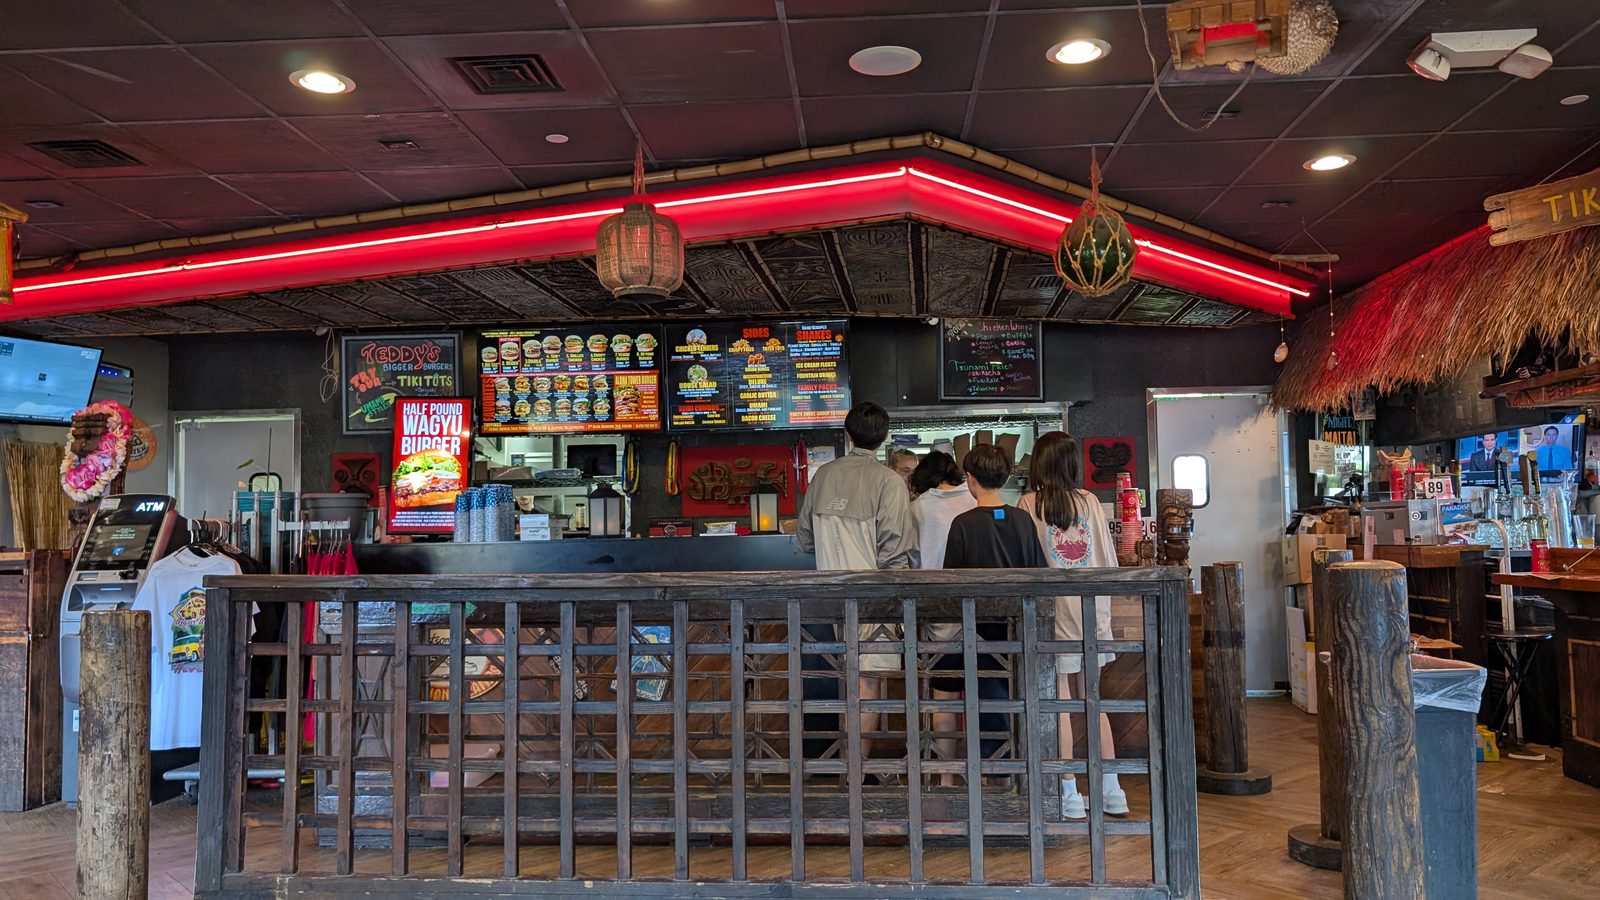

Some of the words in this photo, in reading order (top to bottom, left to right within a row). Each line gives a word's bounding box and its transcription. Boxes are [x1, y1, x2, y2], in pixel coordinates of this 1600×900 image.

[743, 327, 769, 338] SIDES
[797, 330, 832, 340] SHAKES
[361, 342, 441, 370] TEDDY'S
[383, 363, 413, 371] BIGGER
[423, 363, 453, 371] BURGERS
[350, 367, 377, 387] TRY
[397, 375, 422, 387] TIKI
[424, 374, 453, 387] TOTS
[482, 378, 495, 422] FAVORITES
[403, 403, 428, 415] HALF
[430, 403, 463, 415] POUND
[403, 414, 463, 436] WAGYU
[401, 436, 461, 456] BURGER
[1428, 481, 1443, 493] 89
[136, 501, 165, 512] ATM
[1441, 503, 1472, 512] PARADISE
[1109, 521, 1122, 534] 95
